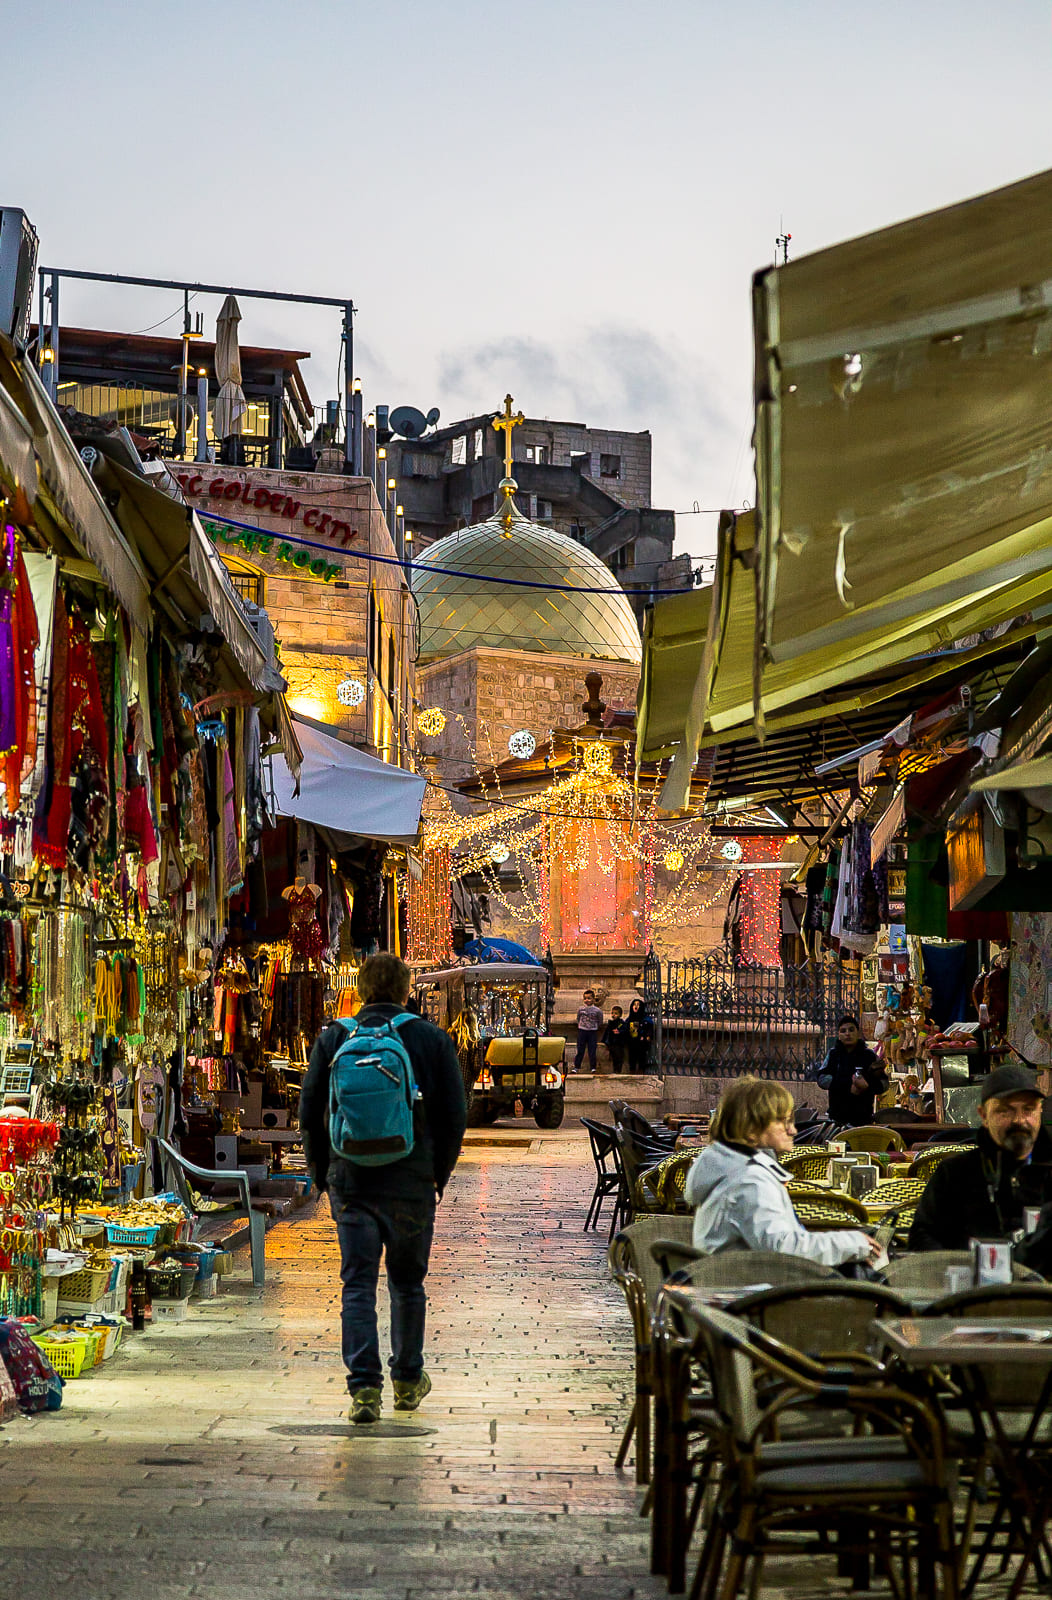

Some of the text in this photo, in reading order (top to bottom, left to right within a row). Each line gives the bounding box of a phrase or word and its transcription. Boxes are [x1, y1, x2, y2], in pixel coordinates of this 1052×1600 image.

[209, 478, 301, 519] GOLDEN
[303, 509, 357, 545] CITY
[275, 542, 342, 583] ROOF
